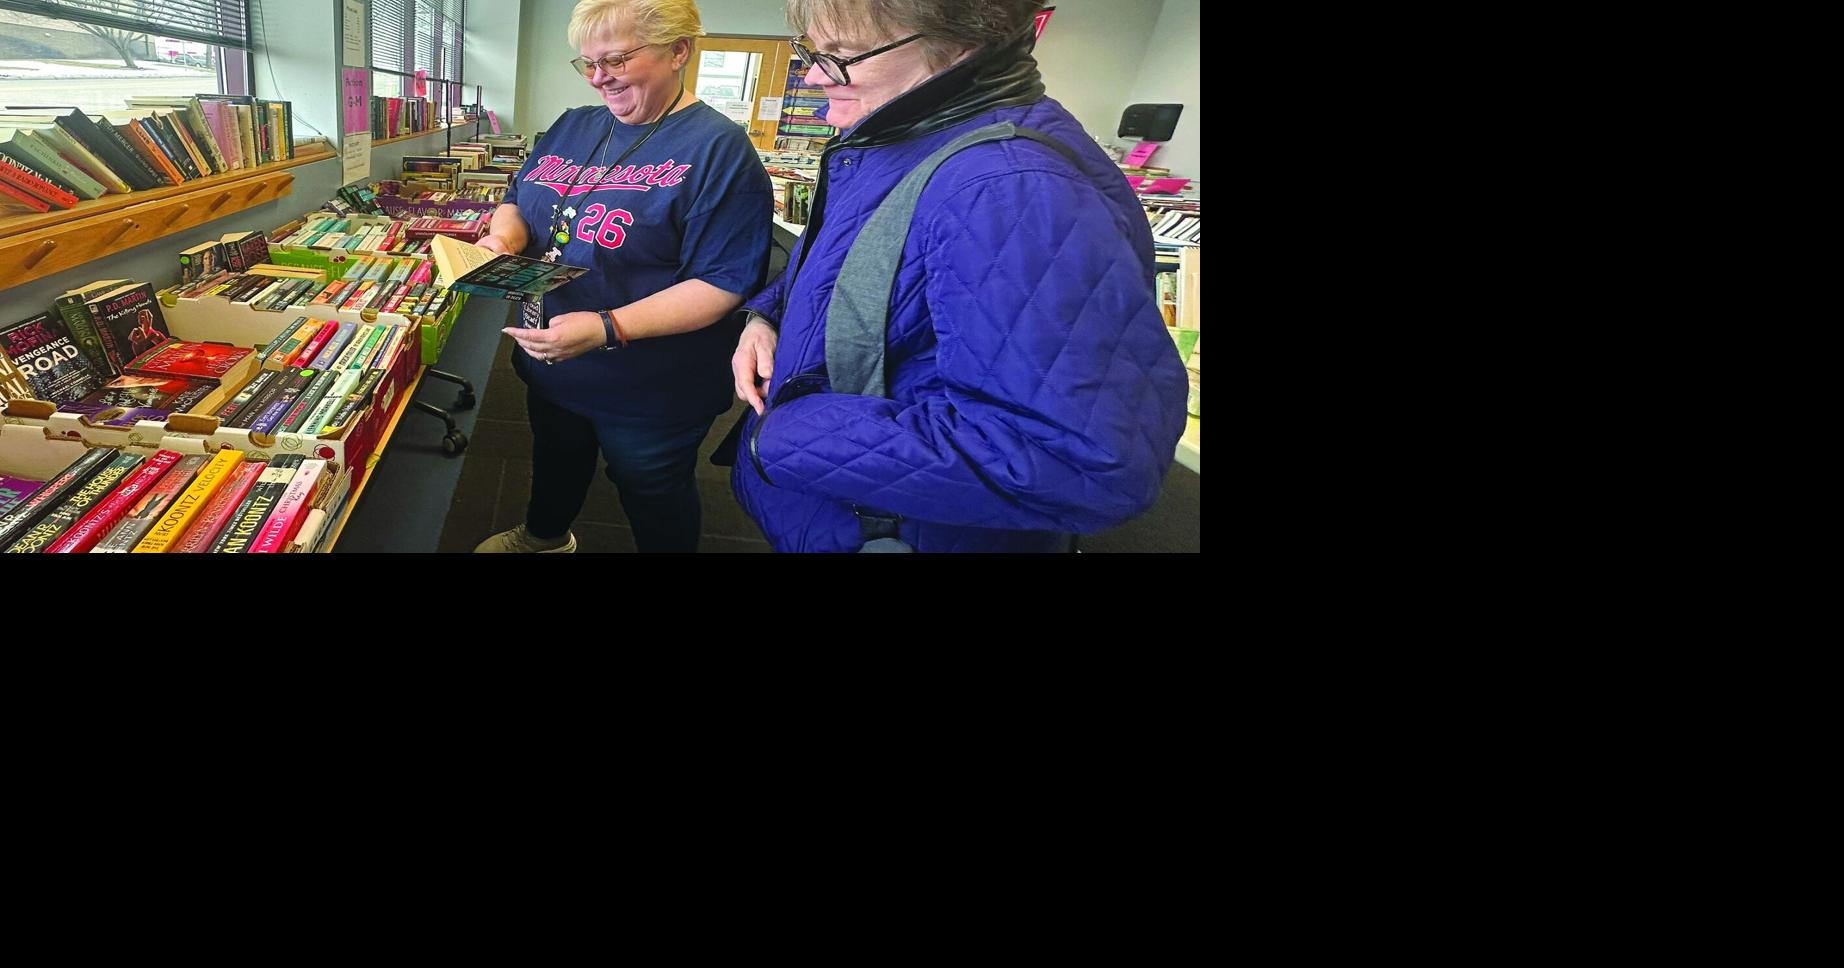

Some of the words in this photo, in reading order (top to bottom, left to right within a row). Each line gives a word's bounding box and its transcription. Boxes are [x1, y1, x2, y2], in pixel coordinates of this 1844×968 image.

[523, 155, 692, 187] Minnesota
[576, 203, 634, 249] 26
[106, 301, 120, 313] P.D.
[120, 291, 147, 308] MARTIN
[11, 336, 70, 366] VENGEANCE
[16, 344, 79, 380] ROAD
[26, 469, 78, 509] WHISPERS
[69, 486, 90, 505] THE
[87, 465, 116, 491] HOUSE
[76, 494, 93, 508] OF
[90, 465, 126, 496] THUNDER
[157, 494, 200, 533] KOONTZ
[196, 458, 229, 493] VELOCITY
[279, 481, 304, 514] CHRISTMAS
[22, 524, 62, 553] OONTZ
[223, 537, 245, 553] AN
[235, 495, 275, 535] KOONTZ
[263, 516, 288, 547] WILDE
